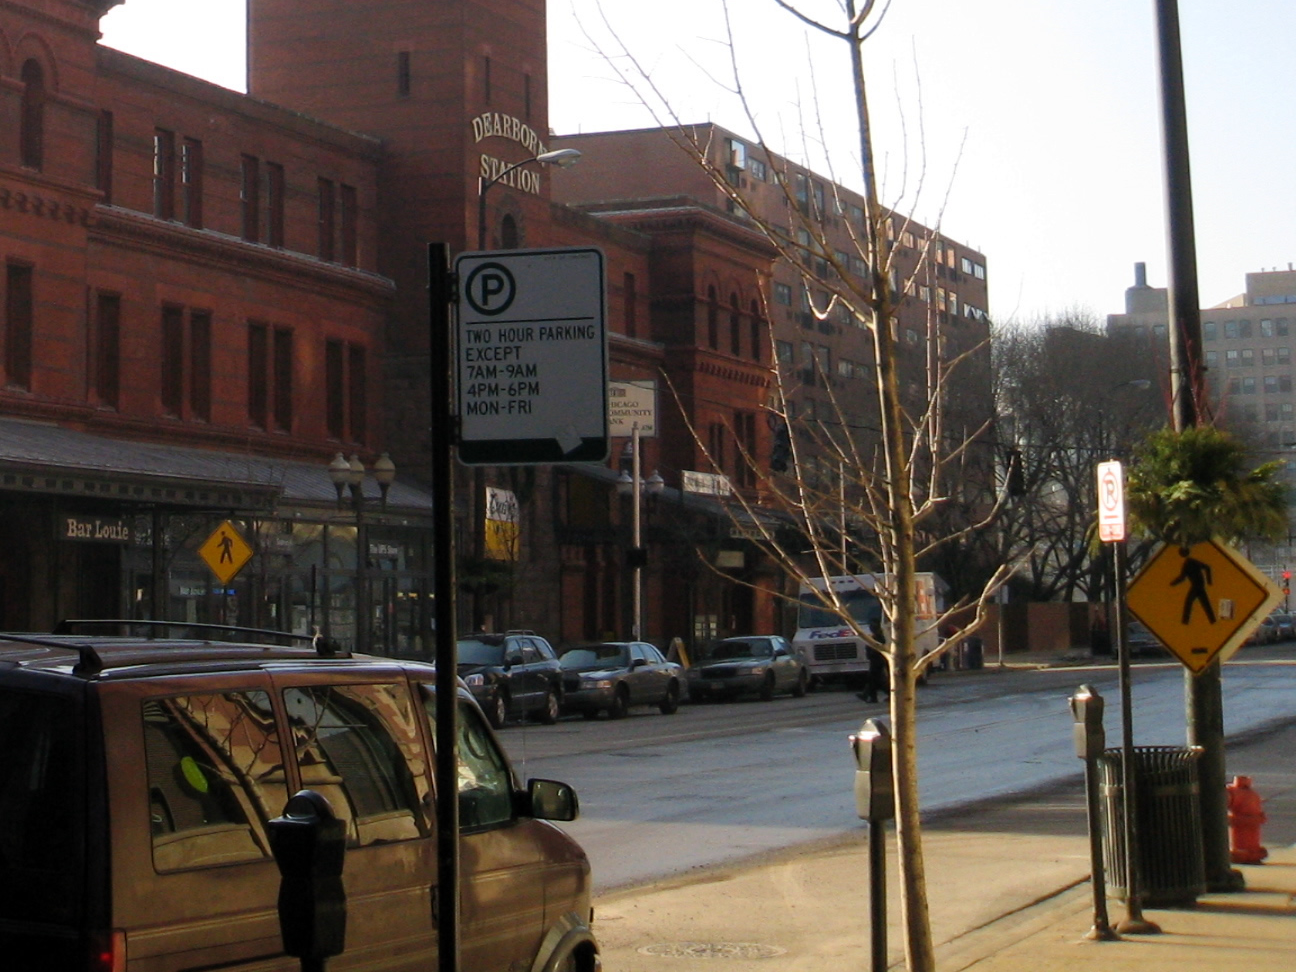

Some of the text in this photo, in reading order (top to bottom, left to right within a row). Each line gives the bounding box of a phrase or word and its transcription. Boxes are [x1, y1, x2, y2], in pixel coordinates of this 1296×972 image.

[471, 111, 549, 168] DEARBORN
[480, 153, 541, 196] STATION
[466, 324, 595, 344] TWO HOUR PARKING
[465, 346, 522, 362] EXCEPT
[466, 363, 538, 380] 7AM-9AM
[467, 381, 540, 398] 4PM-6PM
[467, 399, 532, 416] MON-FRI
[66, 518, 92, 538] Bar
[94, 520, 129, 540] Louie
